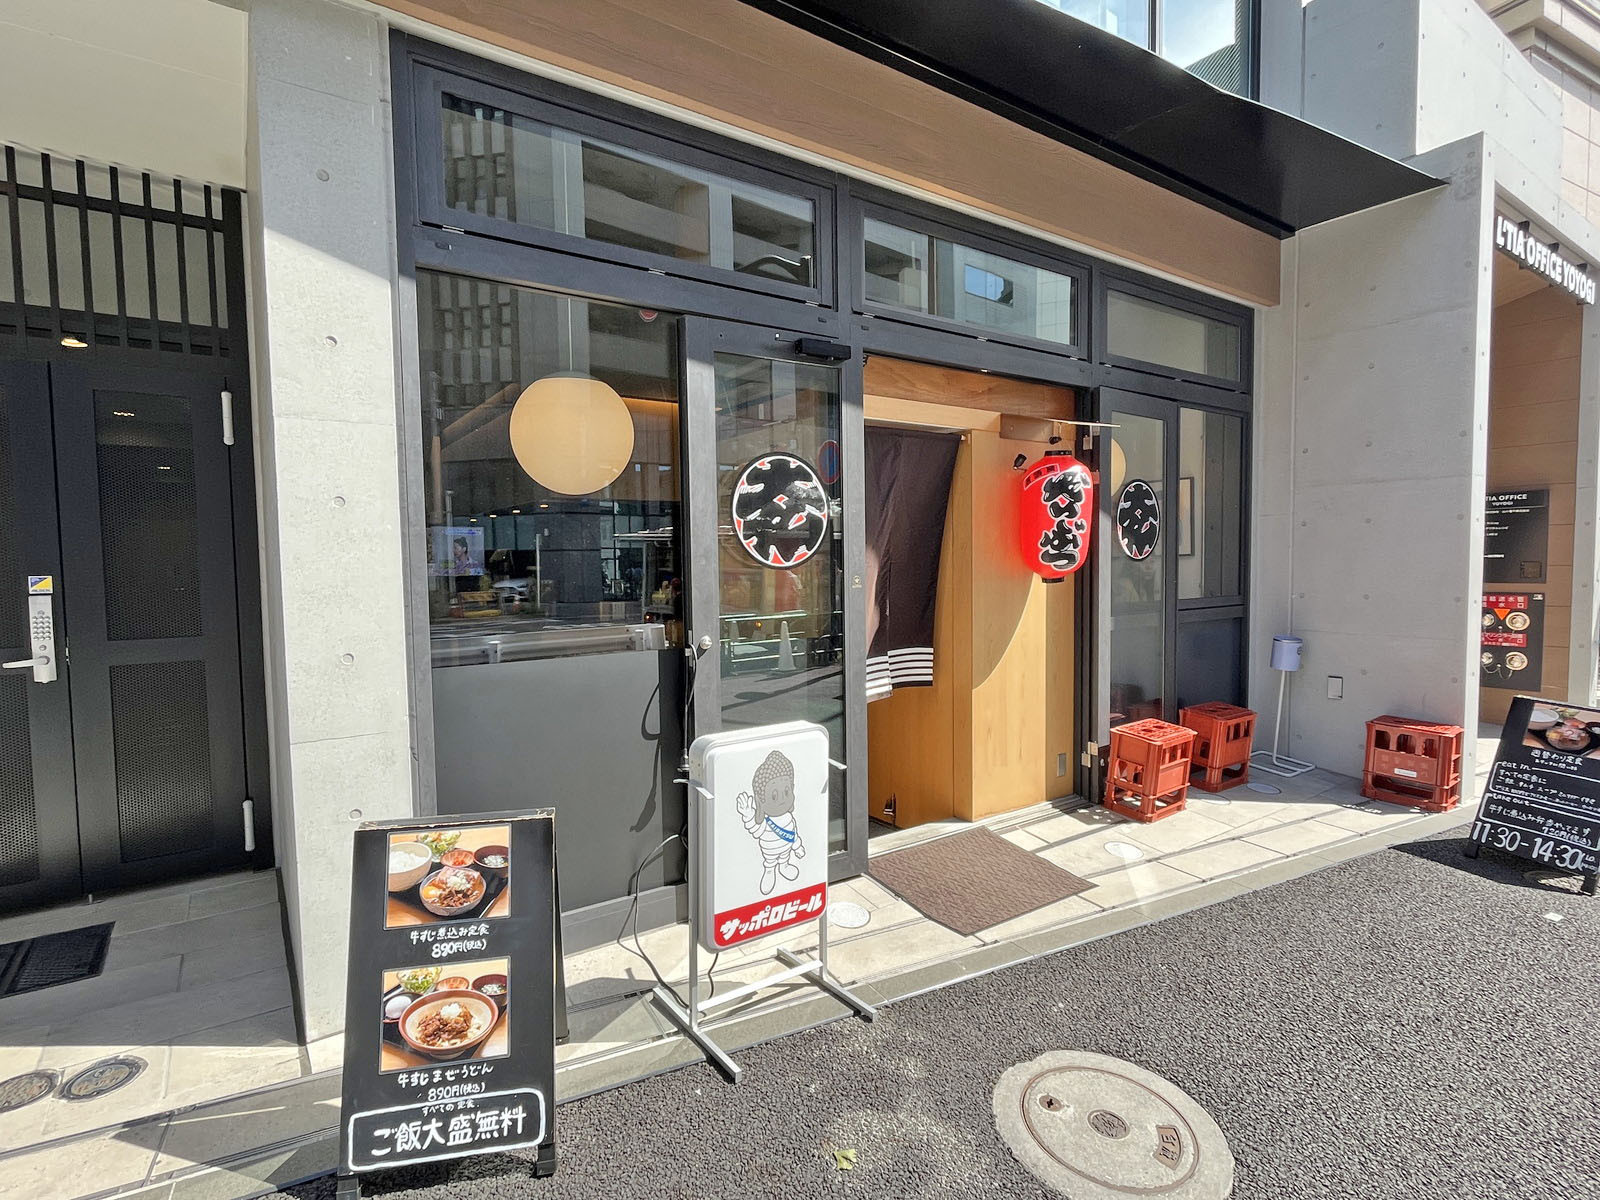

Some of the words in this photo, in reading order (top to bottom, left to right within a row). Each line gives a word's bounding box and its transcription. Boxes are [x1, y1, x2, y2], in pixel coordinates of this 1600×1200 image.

[1526, 237, 1562, 284] OFFICE
[1562, 261, 1596, 305] YOYOGI
[1498, 493, 1528, 502] OFFICE
[1501, 761, 1518, 769] eat
[767, 820, 794, 840] DAIBUTSU
[720, 892, 823, 941] サッポロビール
[410, 923, 490, 945] 牛すじ煮込み定食
[371, 1105, 527, 1156] ご飯大盛無料
